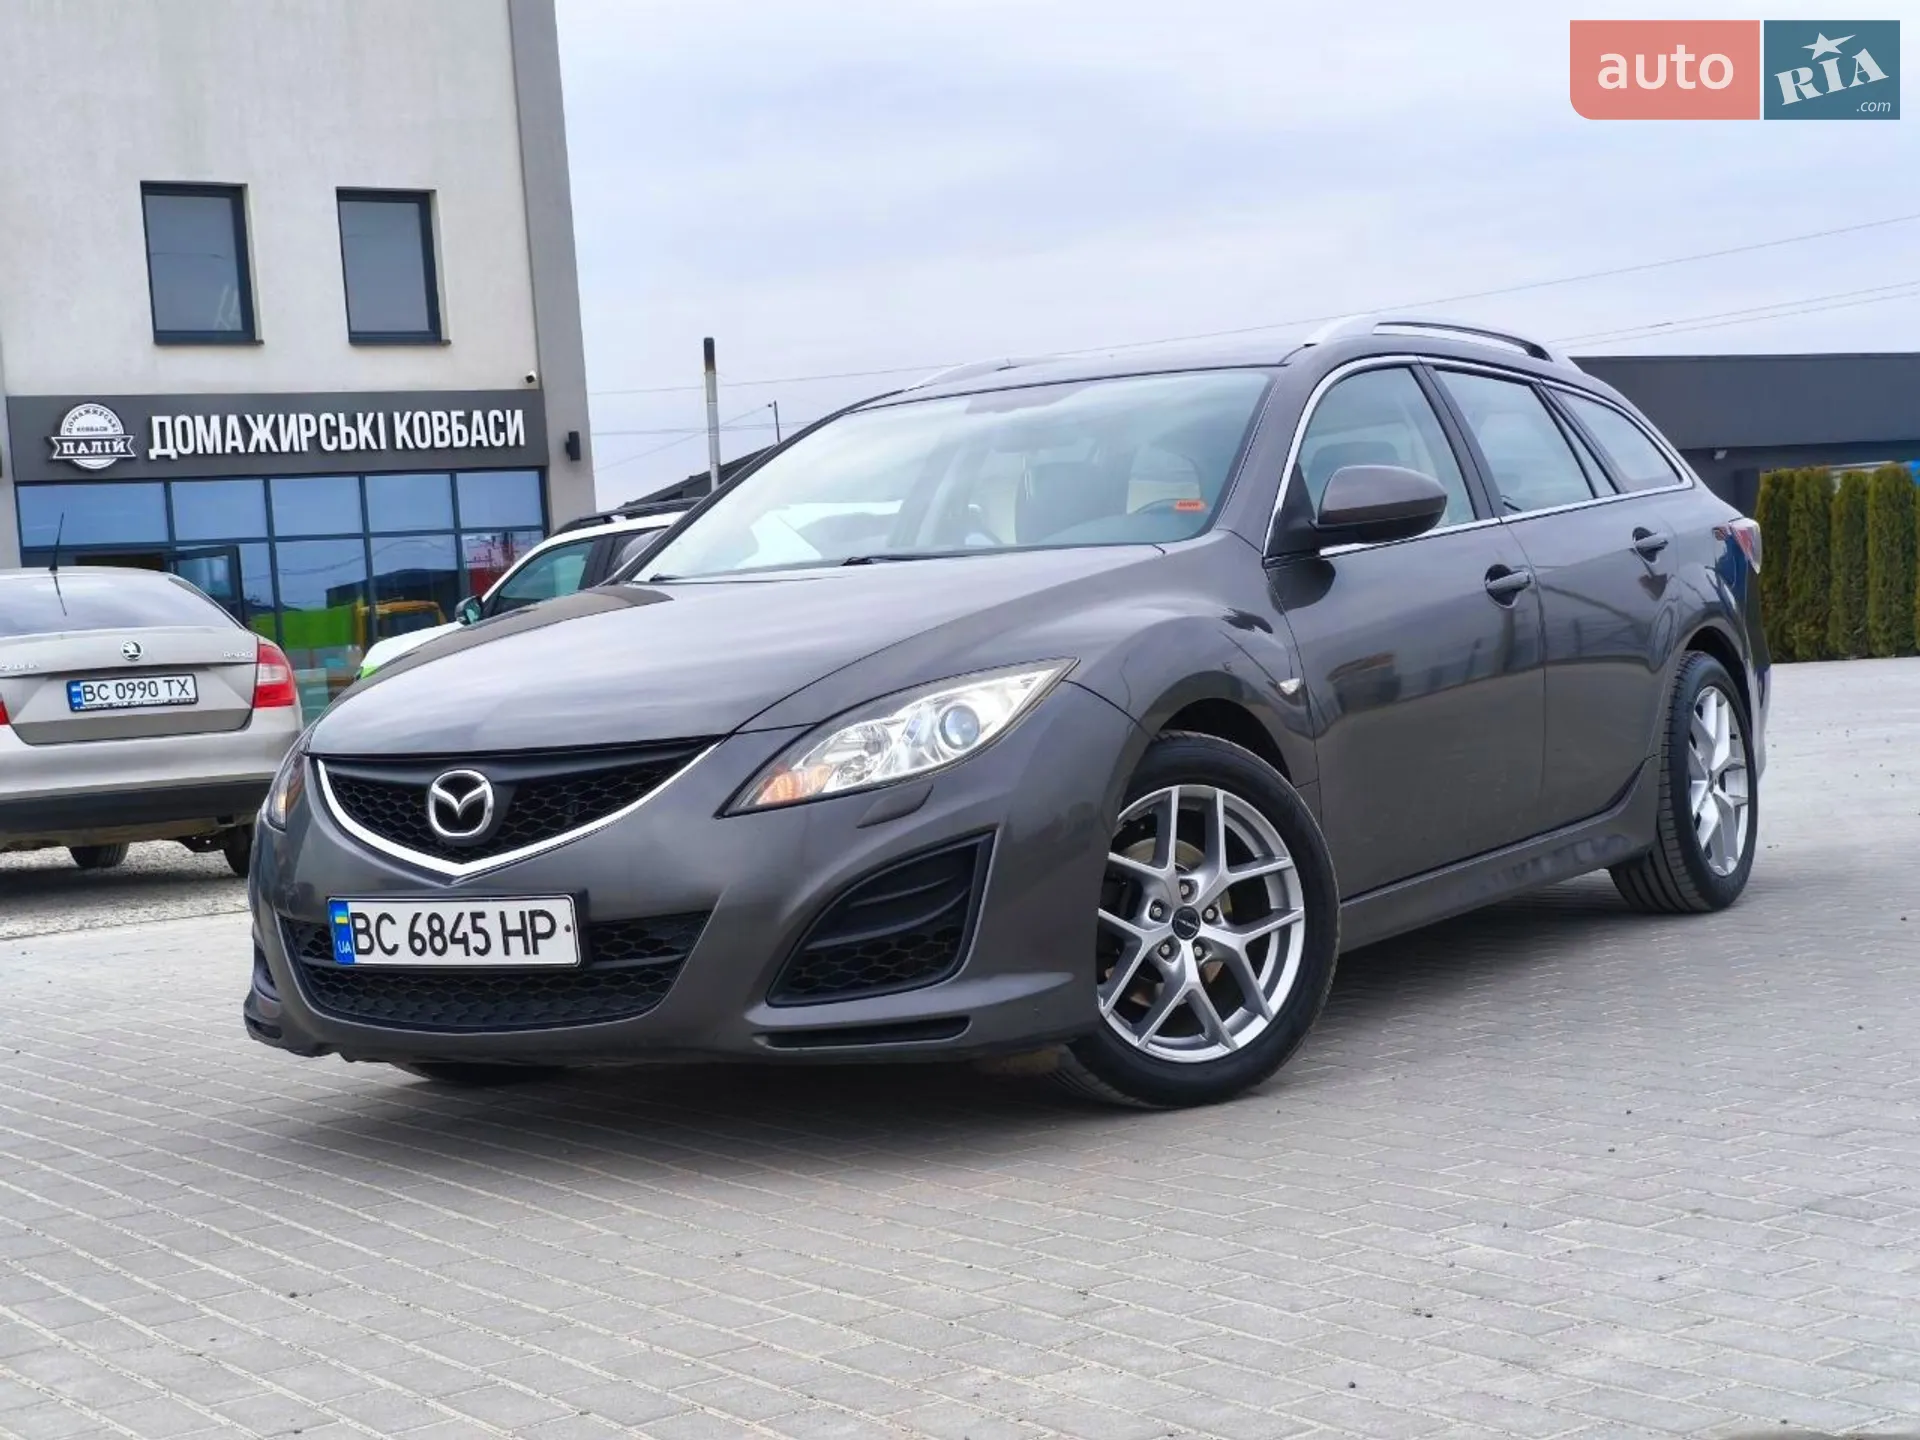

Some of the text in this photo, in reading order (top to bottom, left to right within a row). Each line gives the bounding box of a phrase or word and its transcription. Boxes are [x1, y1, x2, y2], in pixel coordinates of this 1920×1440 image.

[149, 409, 525, 460] ДОМАЖИРСЬКІ КОВБАСИ
[62, 438, 126, 454] ПАЛІЙ
[115, 681, 158, 700] 0990
[350, 909, 557, 957] BC 6845 HP
[337, 942, 352, 954] UA
